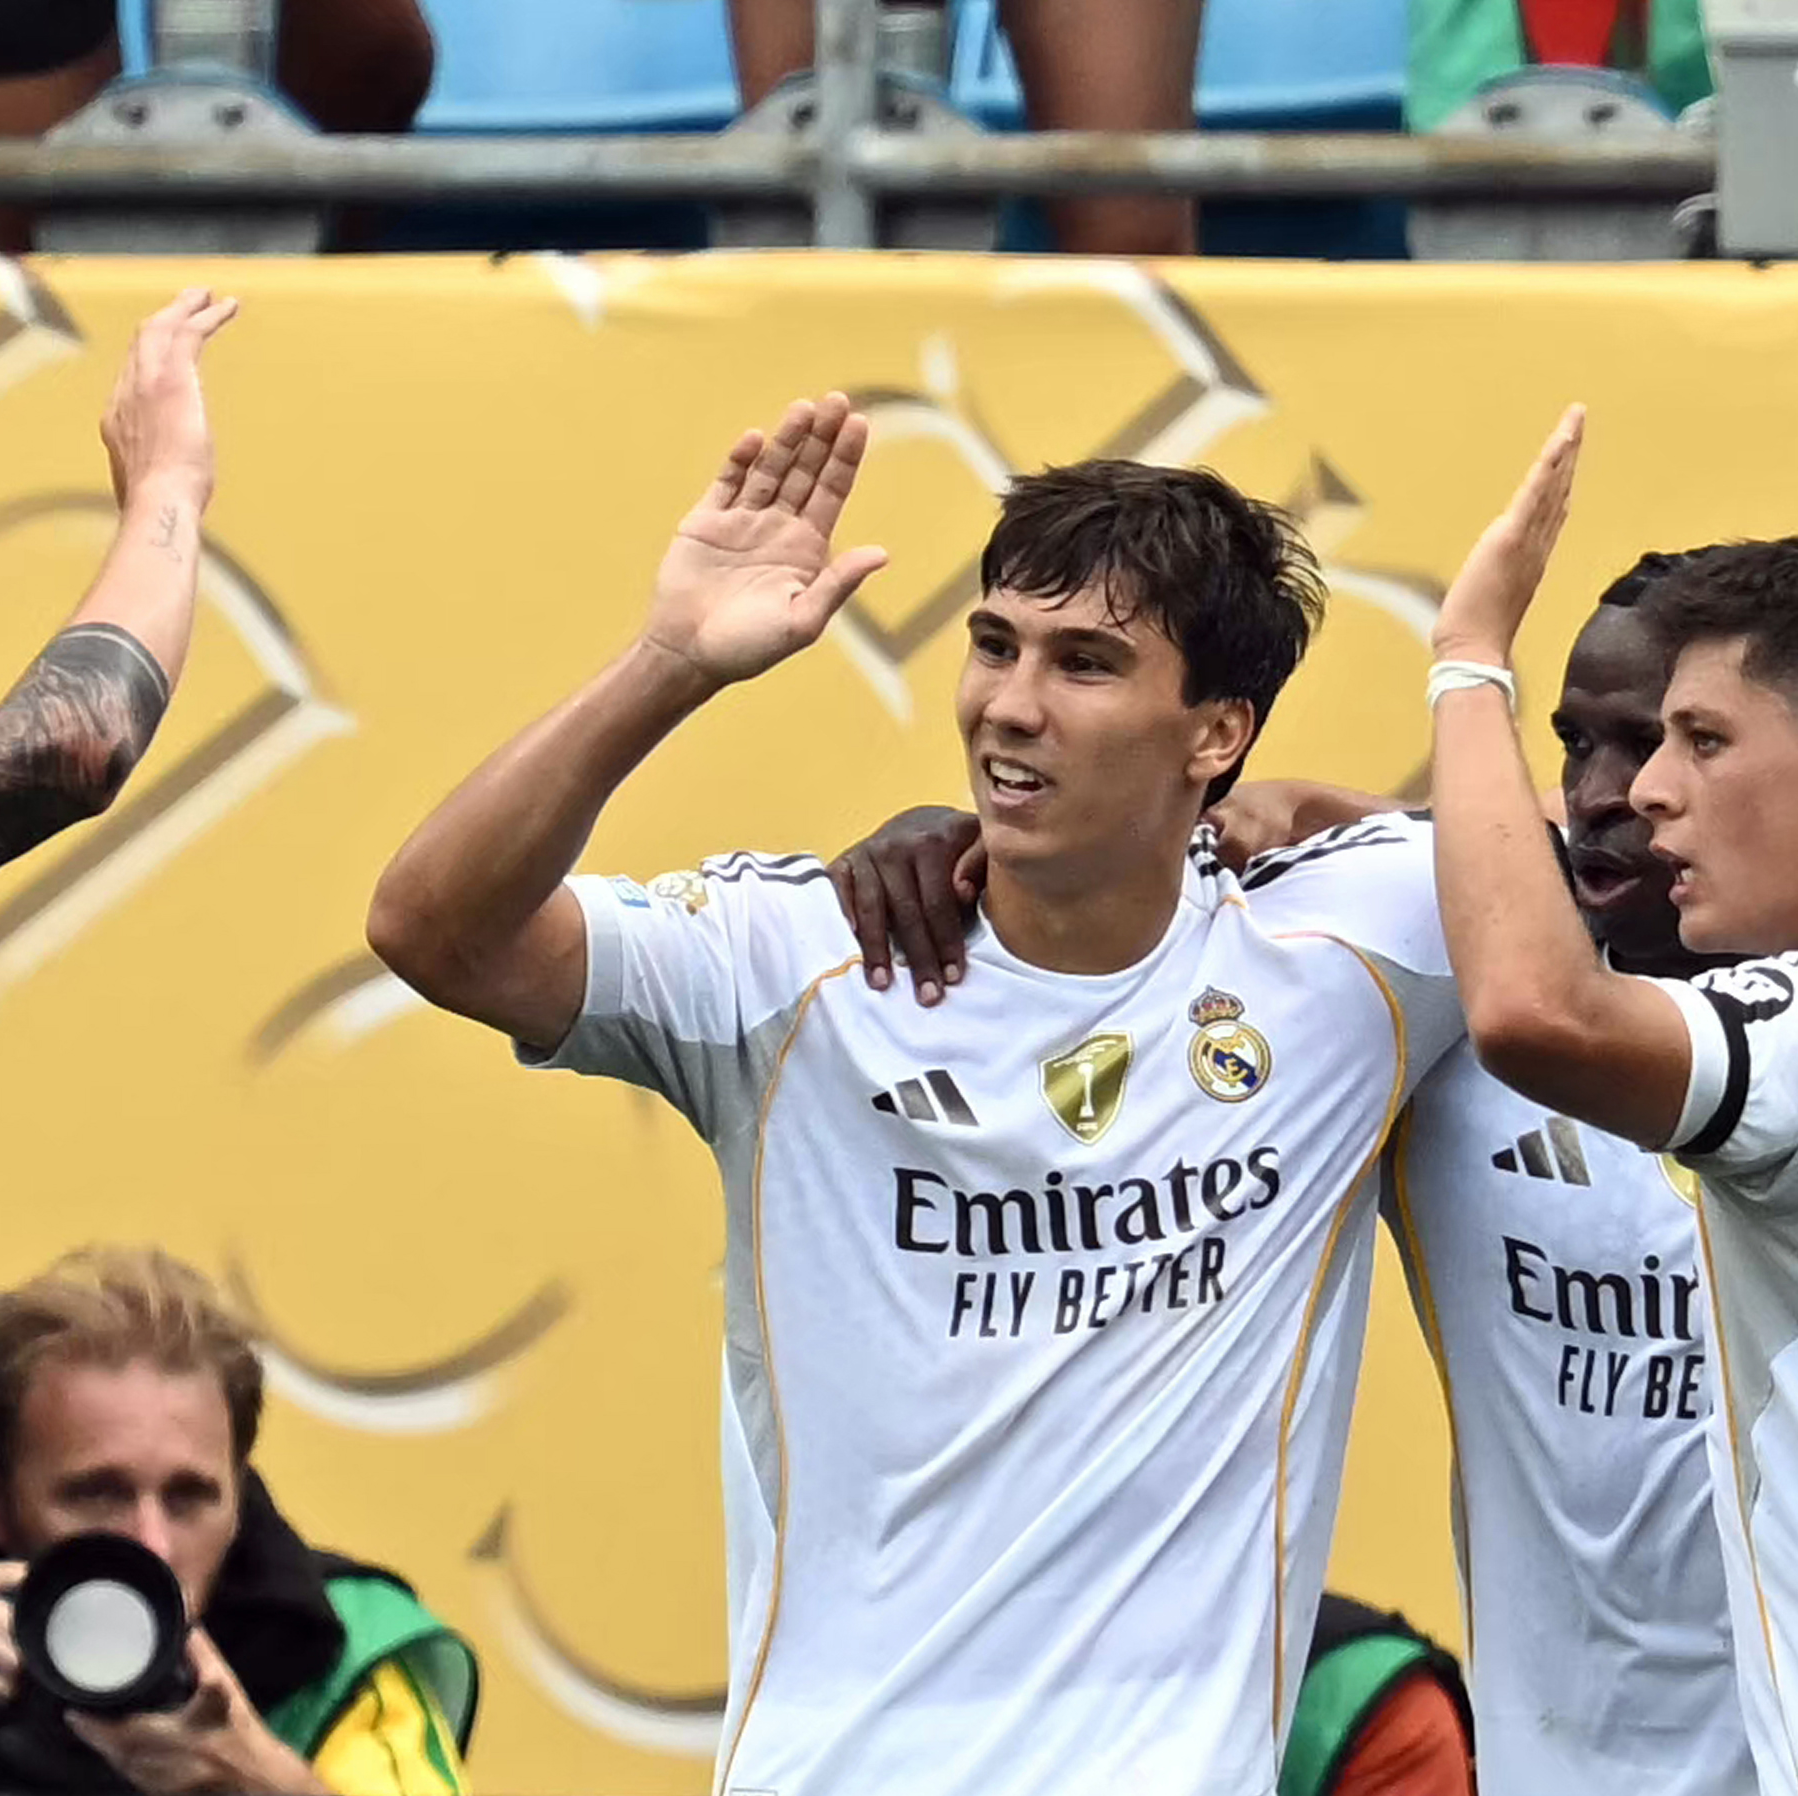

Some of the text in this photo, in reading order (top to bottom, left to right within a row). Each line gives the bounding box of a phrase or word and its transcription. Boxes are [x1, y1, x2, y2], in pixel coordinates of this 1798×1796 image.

[892, 1146, 1280, 1259] Emirates
[949, 1236, 1226, 1339] FLY BETTER
[1502, 1236, 1699, 1340] Emir
[1559, 1345, 1713, 1419] FLY BE
